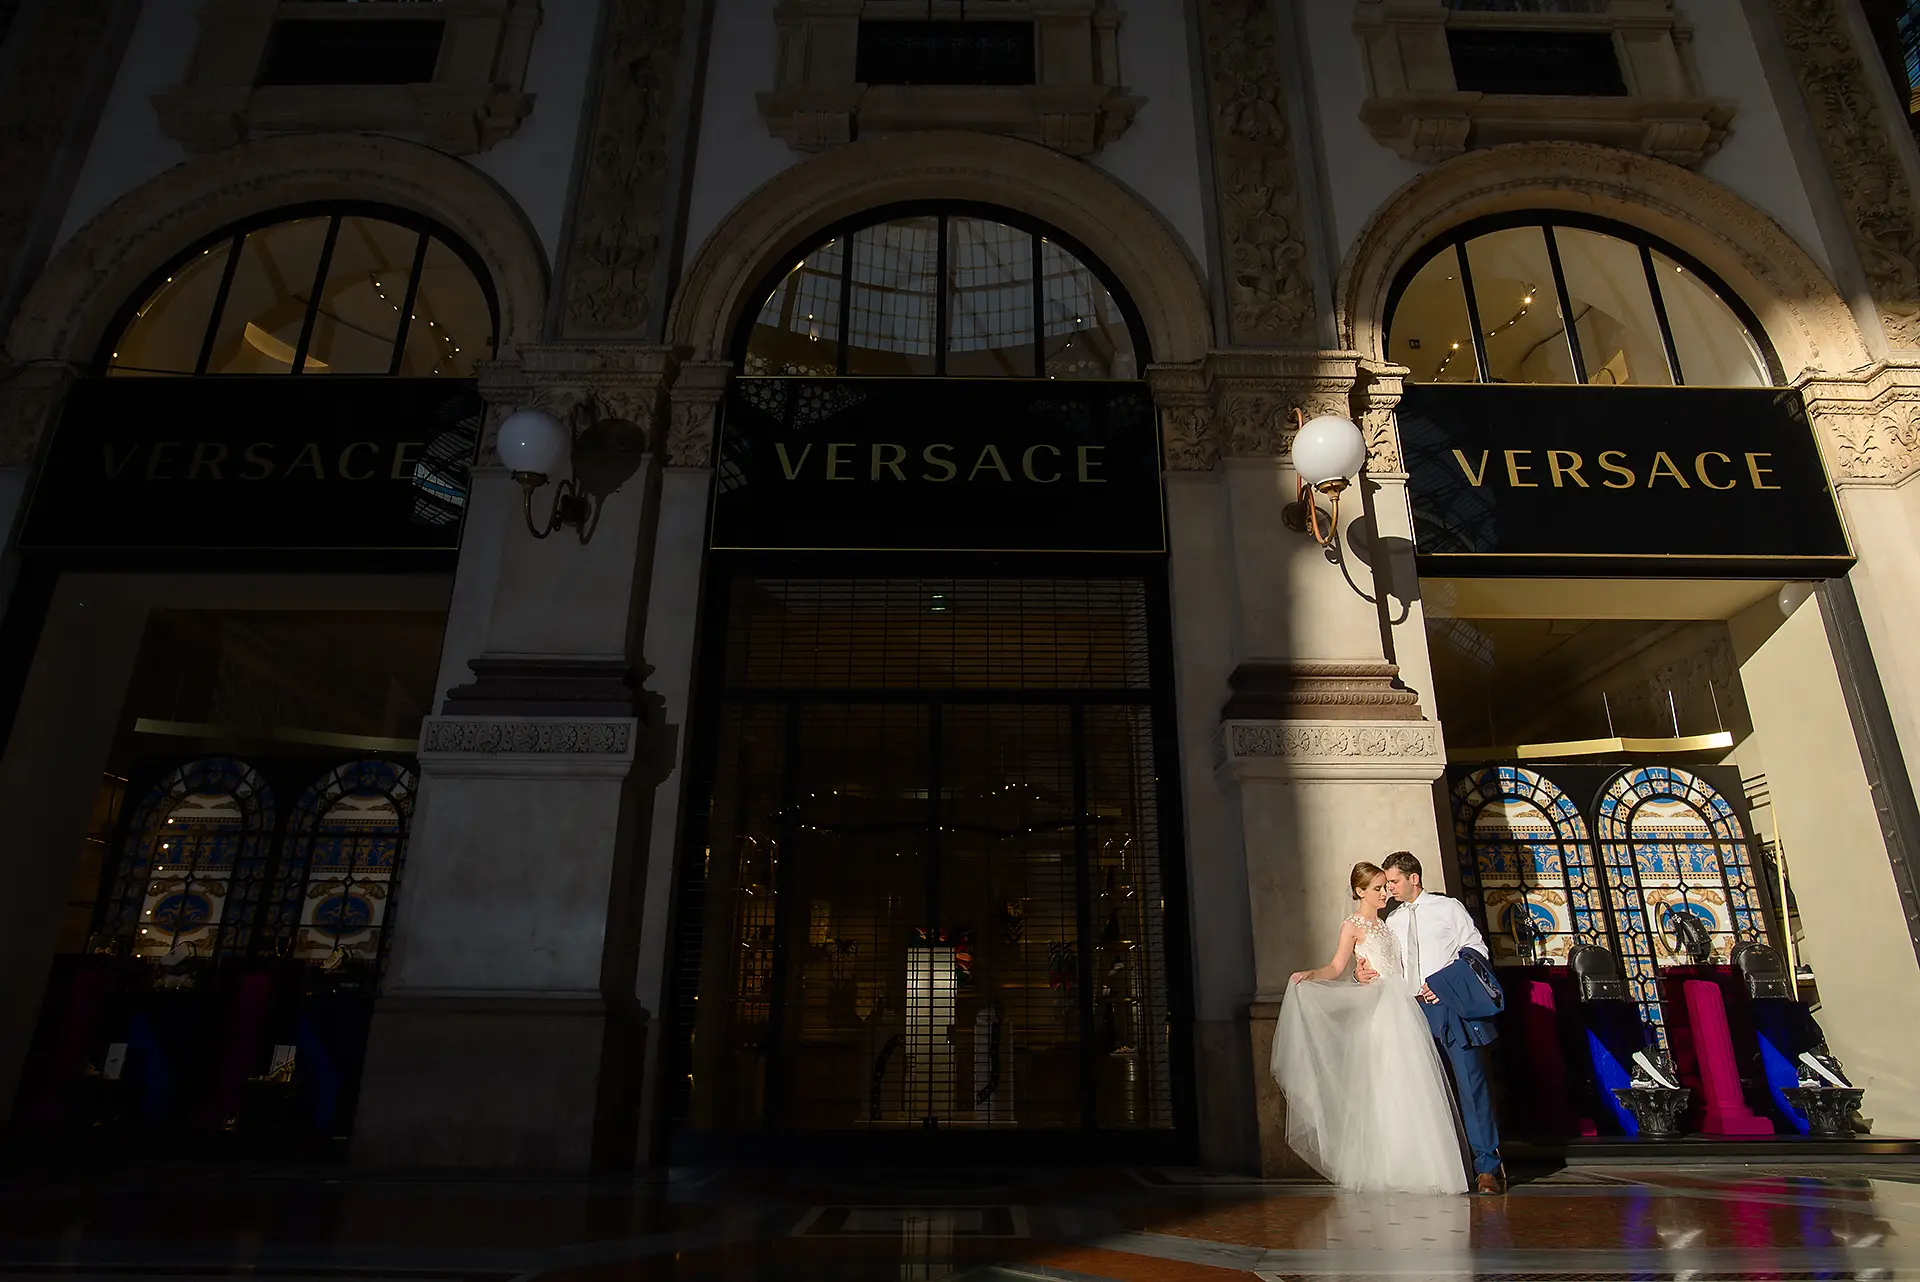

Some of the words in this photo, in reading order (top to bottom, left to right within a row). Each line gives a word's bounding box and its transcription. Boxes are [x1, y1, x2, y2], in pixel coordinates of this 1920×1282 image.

[102, 440, 427, 482] VERSACE
[774, 442, 1107, 484] VERSACE
[1451, 449, 1782, 491] VERSACE
